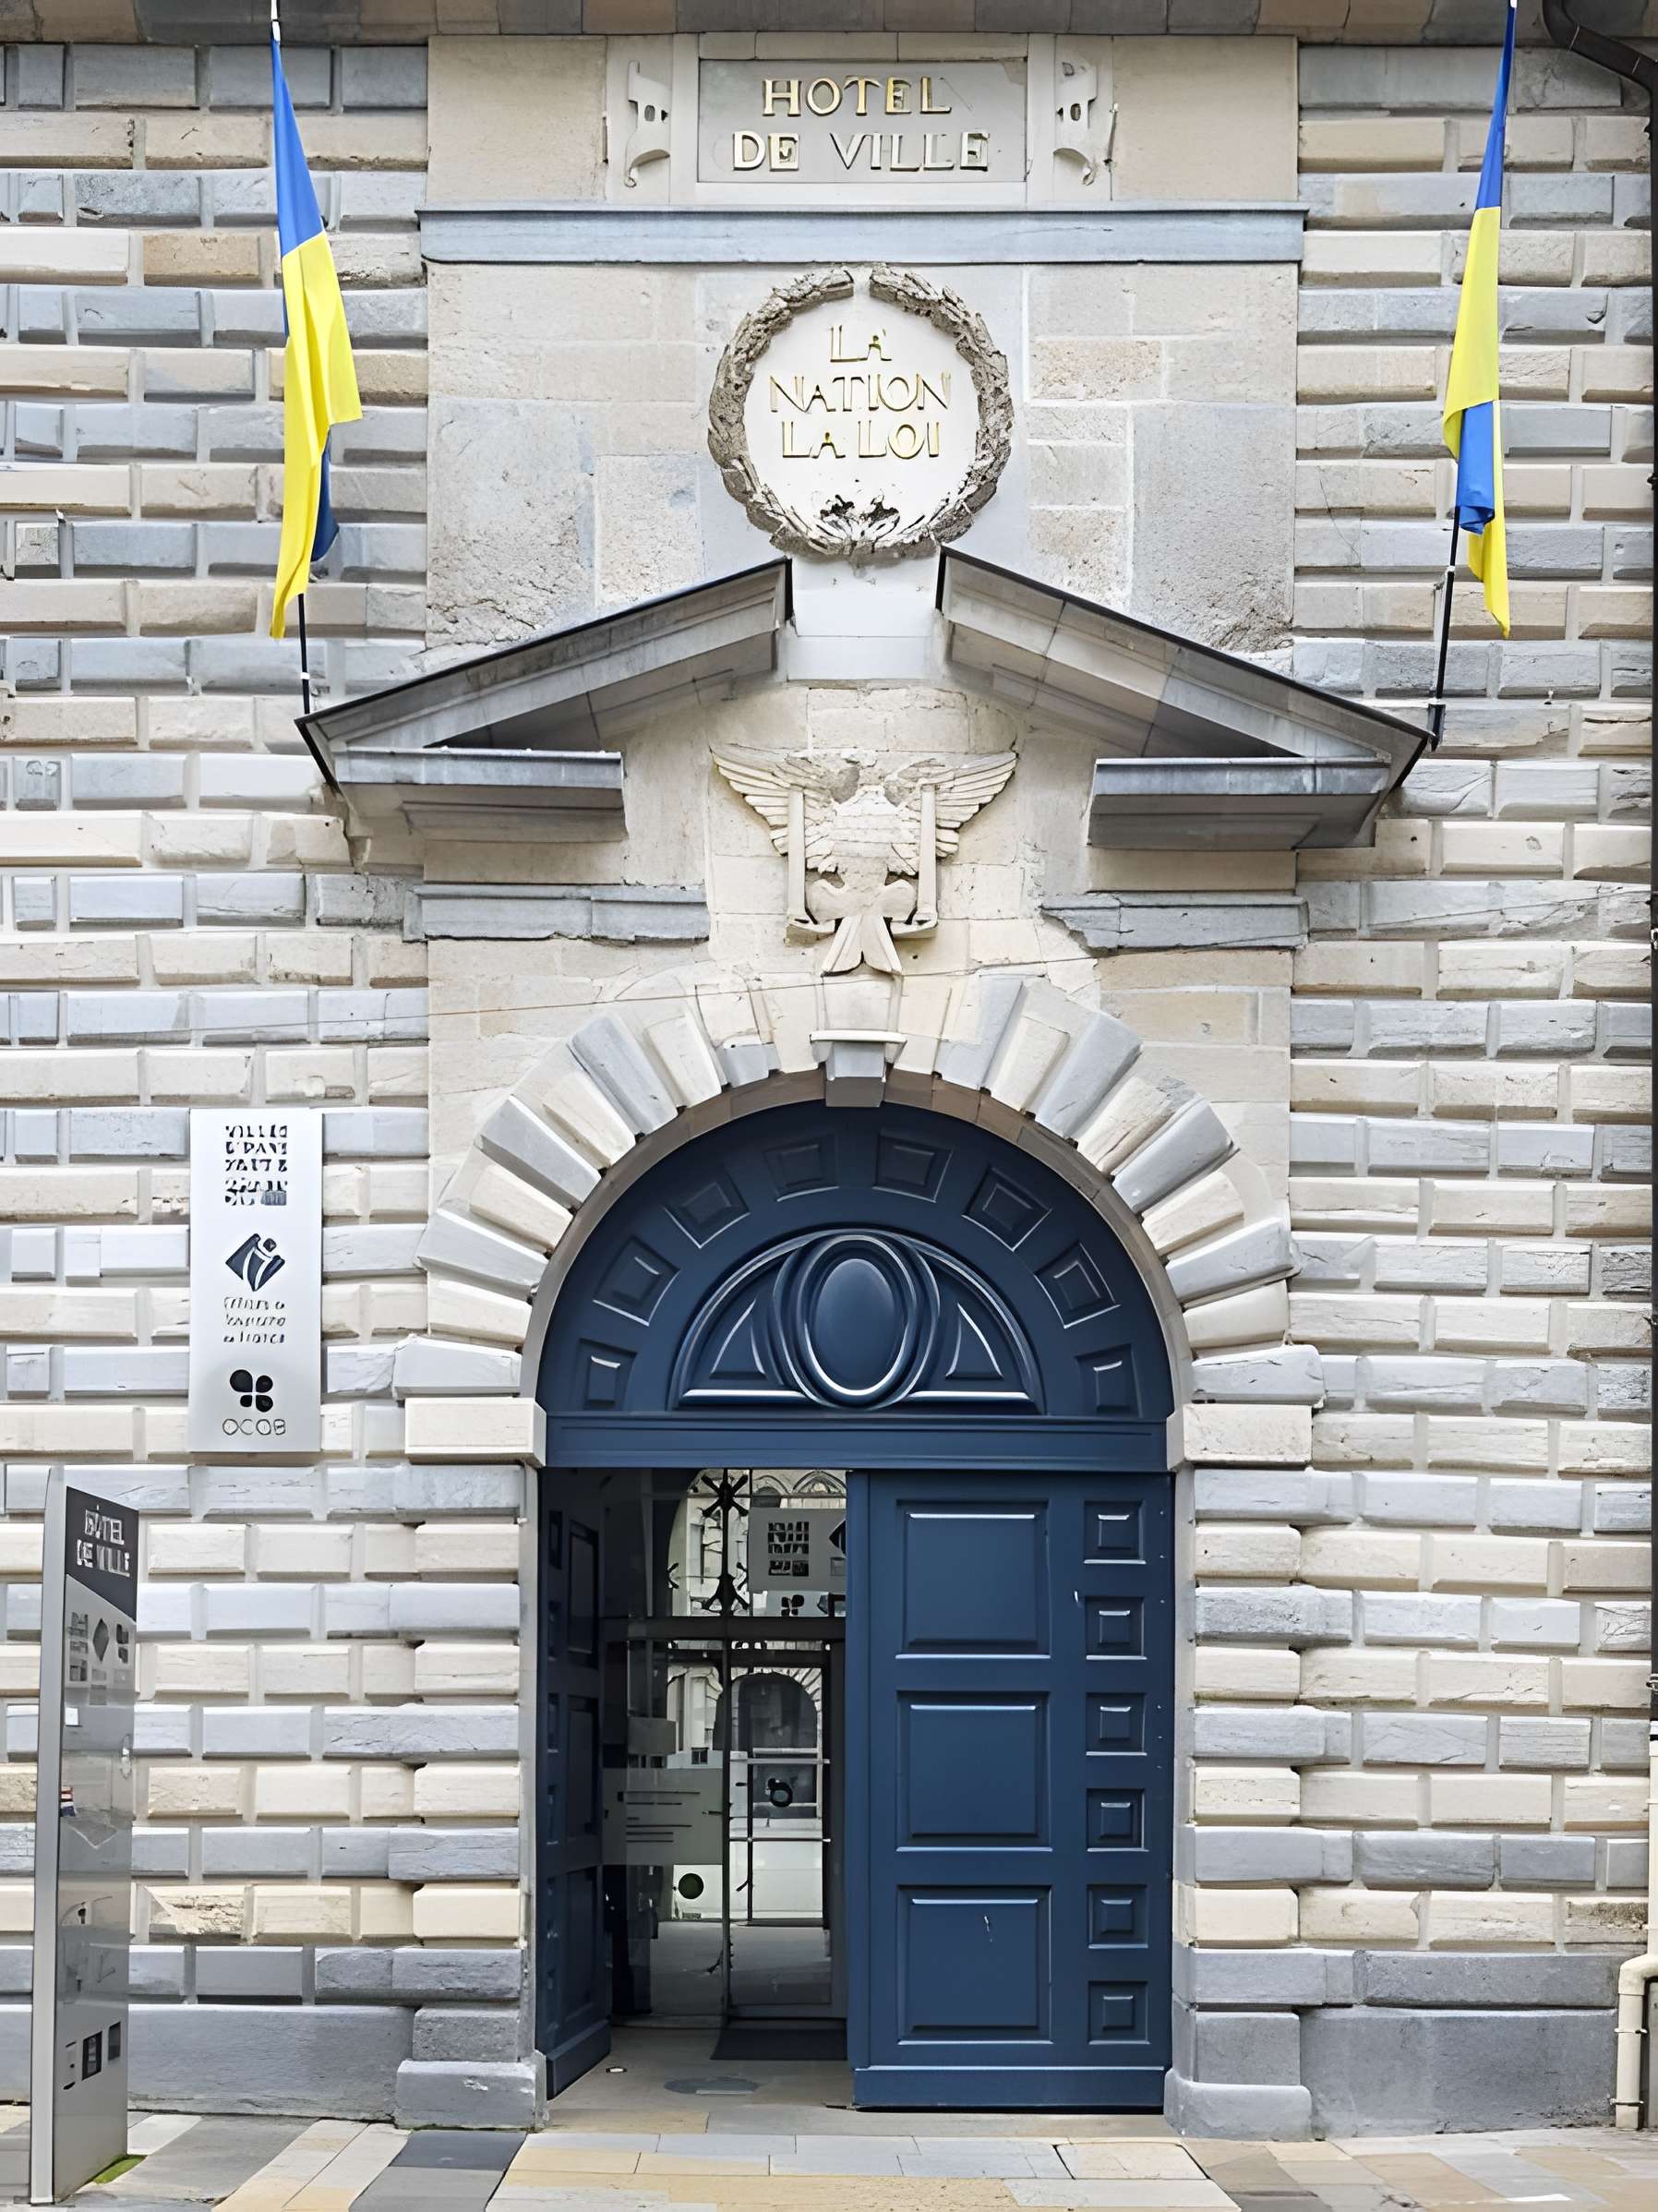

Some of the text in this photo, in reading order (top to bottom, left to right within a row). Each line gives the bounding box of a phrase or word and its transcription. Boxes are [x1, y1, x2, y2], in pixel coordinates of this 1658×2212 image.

[763, 76, 952, 117] HOTEL
[732, 130, 991, 173] DE VILLE
[829, 325, 892, 363] LA
[770, 371, 953, 413] NATION
[781, 420, 941, 460] LA LOI
